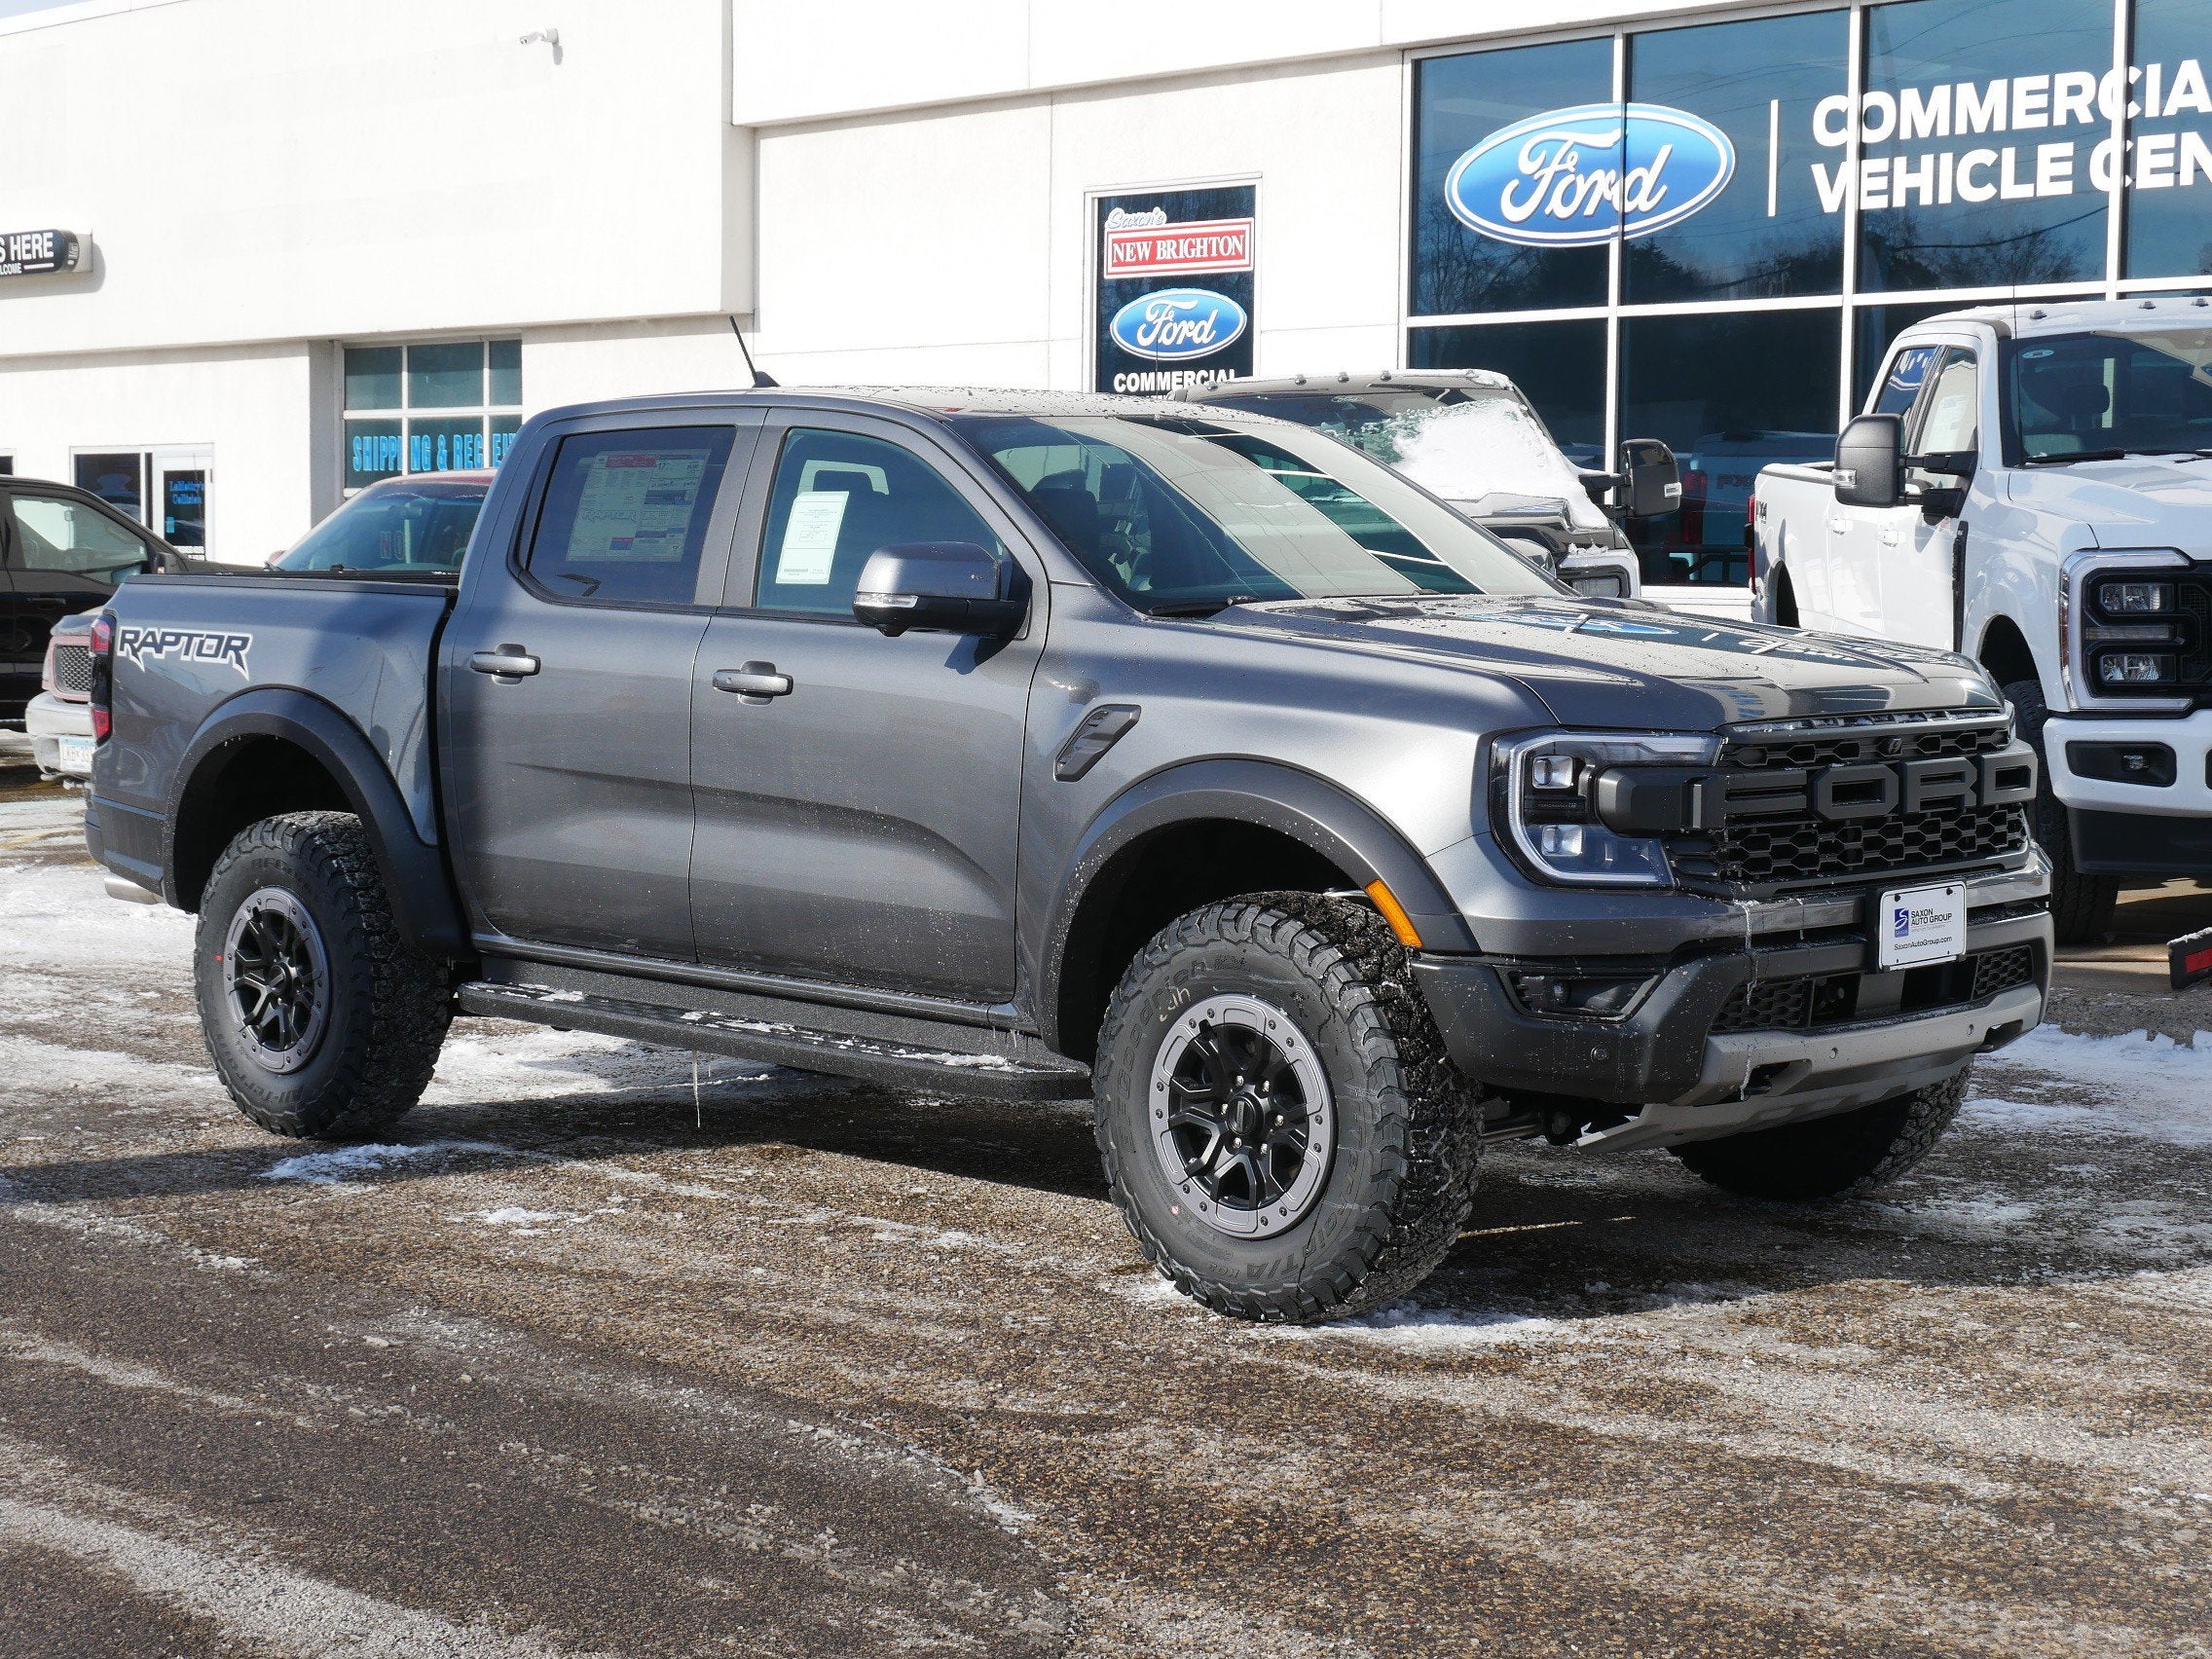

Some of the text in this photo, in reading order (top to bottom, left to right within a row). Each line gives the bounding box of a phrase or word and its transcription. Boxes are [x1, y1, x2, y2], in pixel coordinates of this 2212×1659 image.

[1812, 58, 2212, 146] COMMERCIA
[1500, 129, 1668, 222] Ford
[1811, 140, 2074, 213] VEHICLE
[1107, 207, 1165, 230] Saxon's
[10, 232, 54, 261] HERE
[1112, 234, 1245, 264] NEW BRIGHTON
[1136, 299, 1219, 347] Ford
[352, 434, 431, 471] SHIPPING
[437, 434, 448, 471] &
[117, 626, 253, 682] RAPTOR
[1706, 742, 2038, 828] FORD
[1910, 912, 1952, 927] AUTO GROUP
[1911, 907, 1934, 918] SAXON
[1894, 936, 1952, 951] SaxonAutoGroup.com
